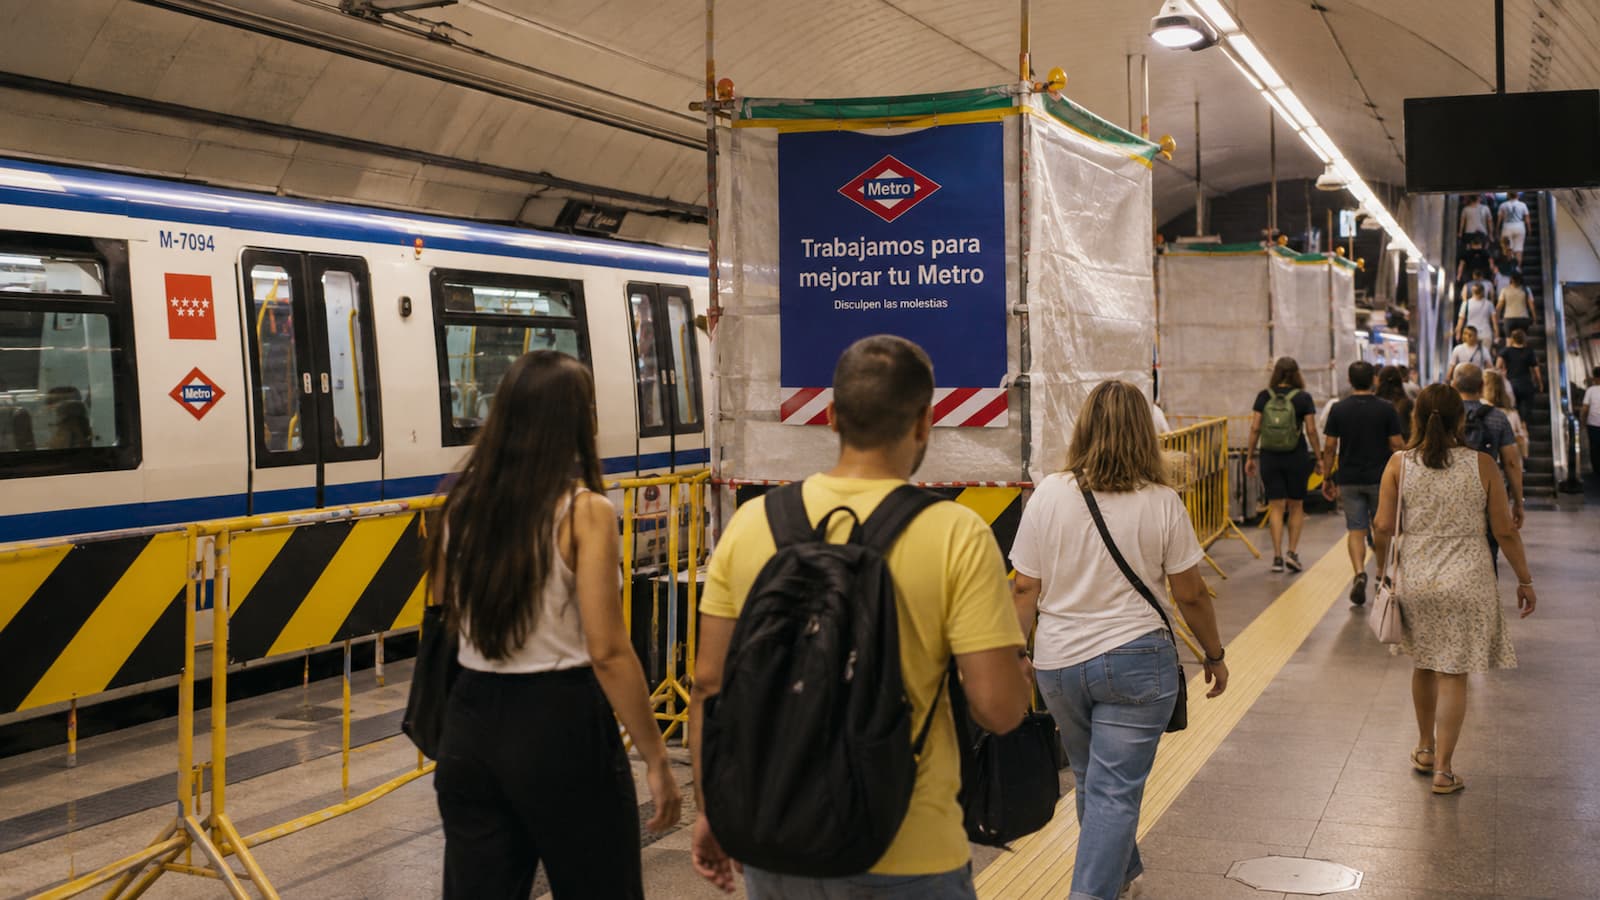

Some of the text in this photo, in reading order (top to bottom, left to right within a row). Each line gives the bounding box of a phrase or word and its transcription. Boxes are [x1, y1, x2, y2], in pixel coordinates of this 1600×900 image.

[867, 182, 912, 196] Metro
[159, 230, 216, 252] M-7094
[801, 236, 981, 262] Trabajamos para
[799, 264, 985, 292] mejorar tu Metro
[834, 298, 949, 311] Disculpen las molestias
[185, 387, 211, 399] Metro
